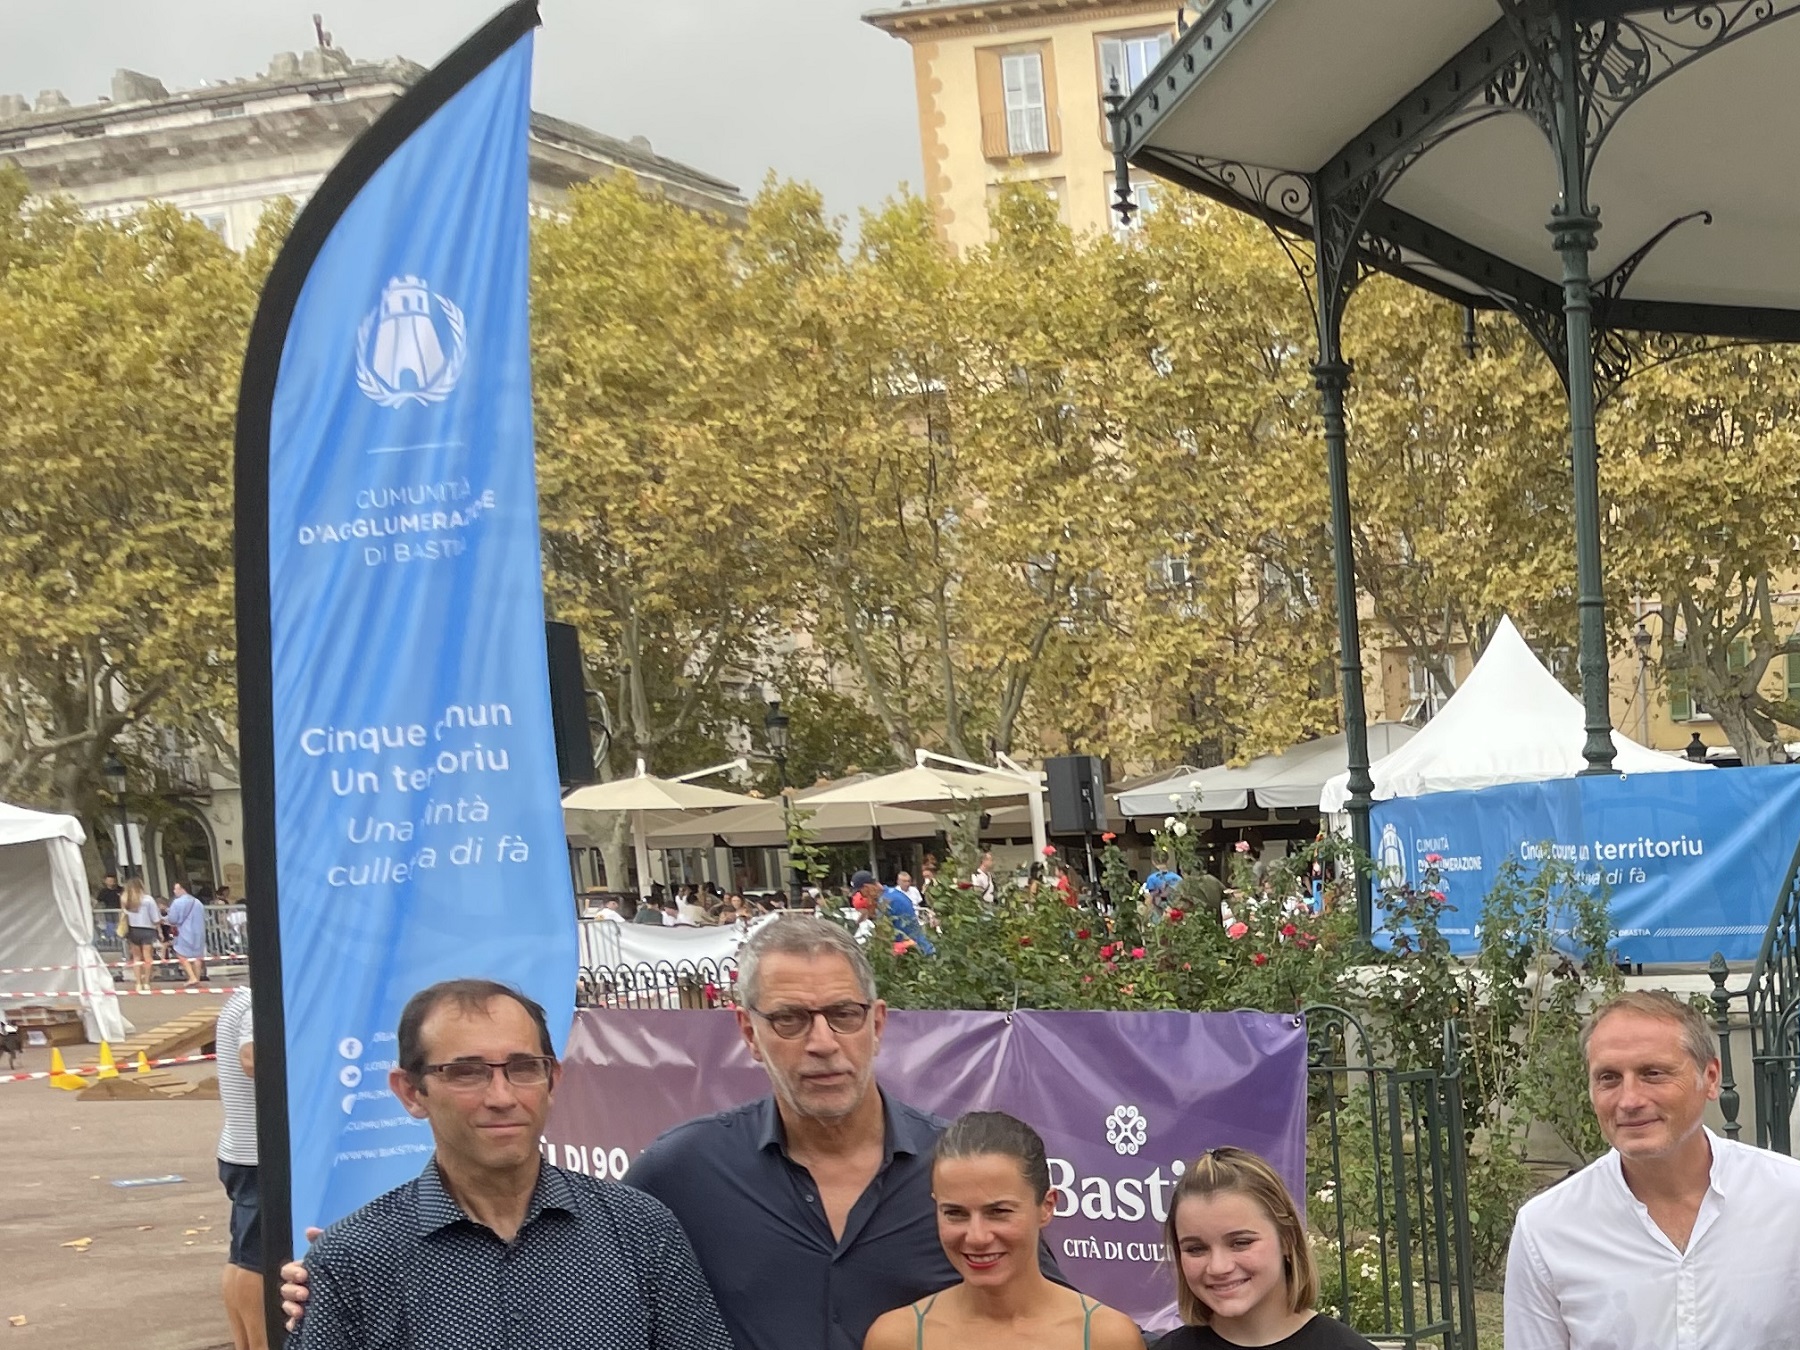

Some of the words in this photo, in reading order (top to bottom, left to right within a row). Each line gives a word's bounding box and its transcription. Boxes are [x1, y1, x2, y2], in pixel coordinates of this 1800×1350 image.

[301, 721, 427, 757] Cinque
[331, 767, 379, 796] Un
[347, 816, 414, 844] Una
[449, 837, 485, 866] di
[496, 834, 530, 863] fà
[1594, 835, 1704, 861] territoriu
[1606, 867, 1623, 885] di
[1629, 867, 1647, 884] fà
[1063, 1236, 1101, 1259] CITÀ
[1104, 1241, 1124, 1260] DI
